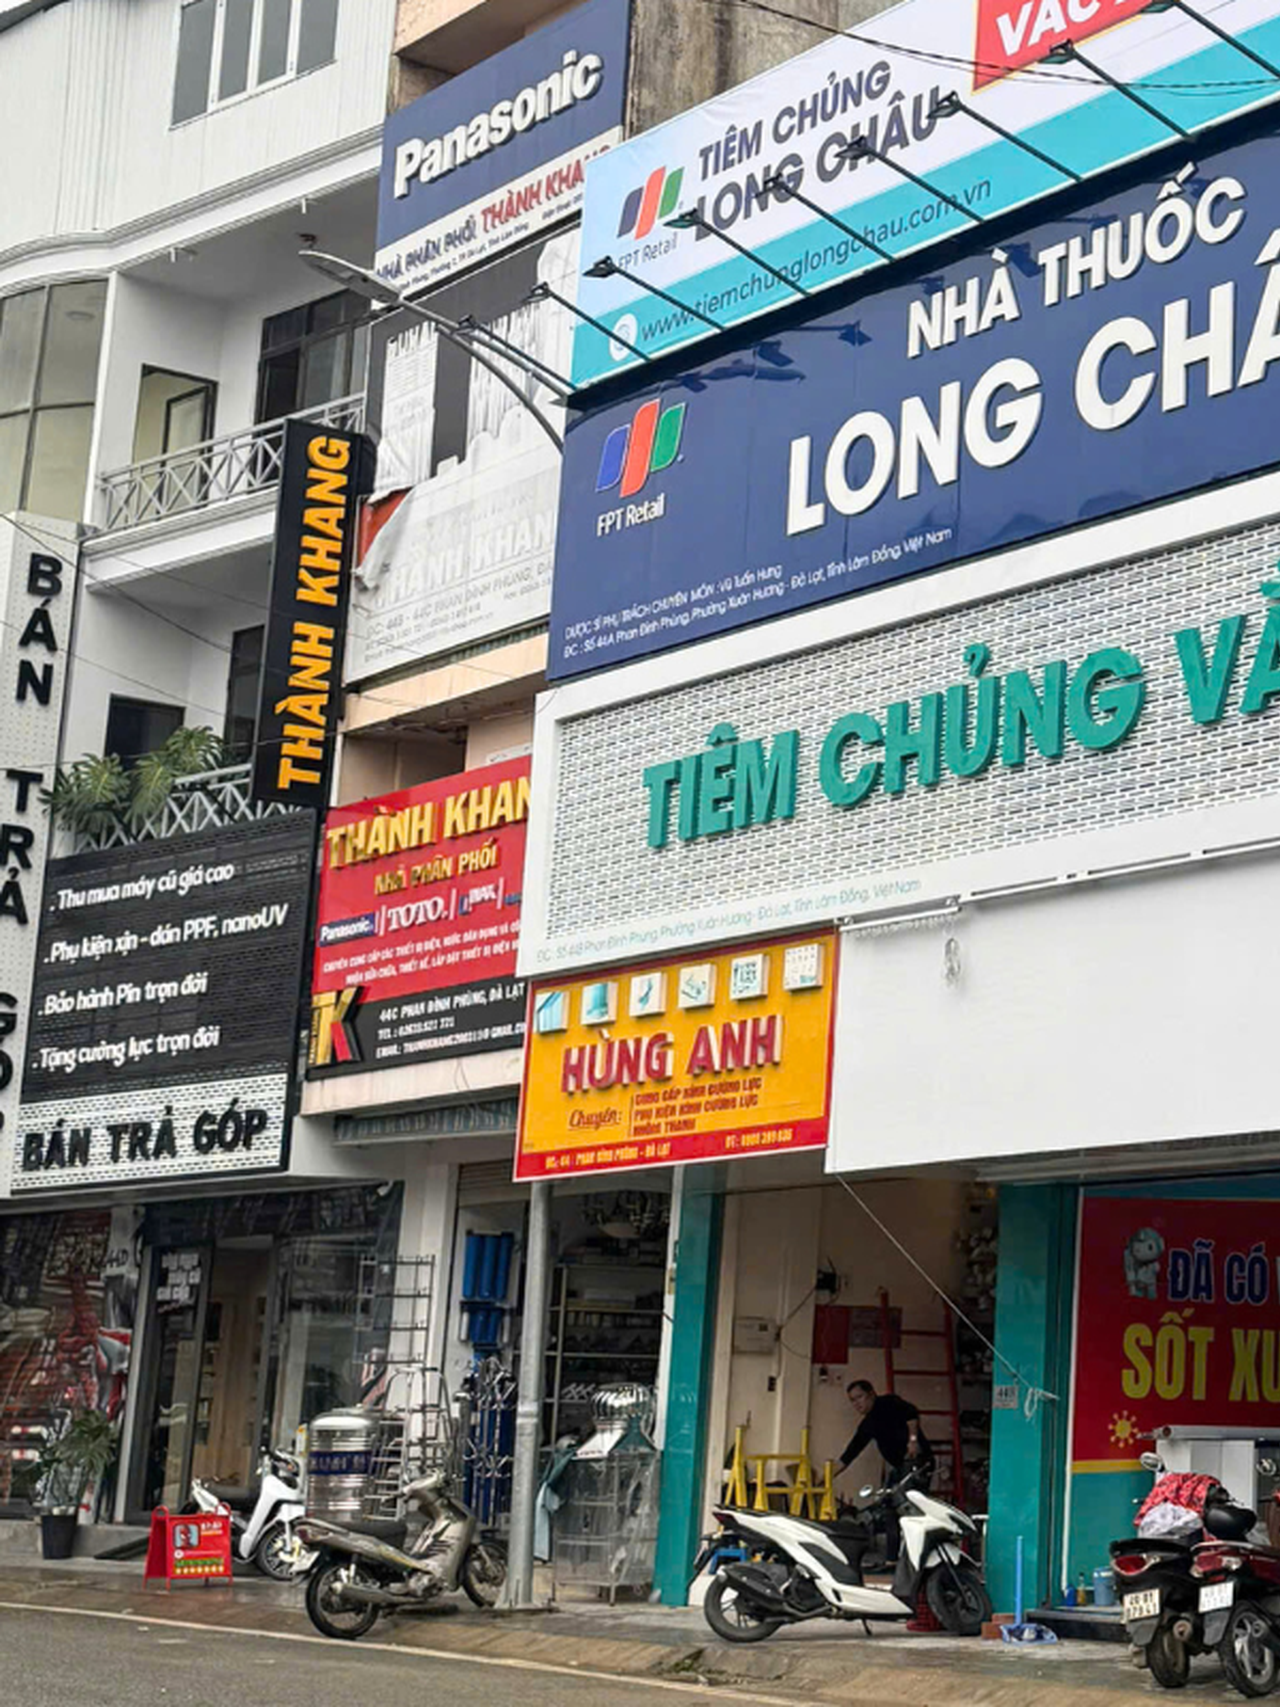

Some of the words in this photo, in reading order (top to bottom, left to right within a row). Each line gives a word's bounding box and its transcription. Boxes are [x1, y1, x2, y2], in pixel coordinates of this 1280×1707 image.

[393, 50, 603, 198] Panasonic
[700, 126, 762, 182] TIÊM
[772, 60, 892, 145] CHỦNG
[695, 153, 805, 242] LONG
[815, 86, 942, 185] CHÂU
[481, 183, 543, 234] THÀNH
[641, 232, 679, 264] Retail
[641, 179, 992, 342] www.tiemchunglongchau.com.vn
[907, 247, 1021, 360] NHÀ
[1038, 162, 1247, 307] THUỐC
[785, 357, 1044, 537] LONG
[296, 435, 352, 607] KHANG
[597, 507, 625, 537] FPT
[626, 492, 666, 523] Retail
[615, 626, 639, 644] Phan
[924, 528, 953, 548] Nam
[15, 552, 63, 707] BÁN
[275, 620, 335, 790] THÀNH
[642, 721, 800, 850] TIÊM
[820, 643, 1147, 808] CHỦNG
[326, 803, 436, 871] THÀNH
[374, 863, 408, 896] NHÀ
[410, 856, 453, 888] PHÂN
[458, 837, 501, 876] PHỐI
[58, 888, 89, 910] Thu
[88, 884, 120, 905] mua
[121, 876, 156, 904] máy
[157, 872, 179, 890] cũ
[180, 864, 205, 896] giá
[205, 863, 235, 881] cao
[50, 941, 81, 964] Phụ
[81, 931, 114, 960] kiện
[115, 930, 139, 953] xịn
[149, 923, 181, 947] dán
[221, 903, 289, 937] nanoUV
[319, 918, 374, 943] Panasonic
[44, 990, 75, 1015] Bảo
[75, 985, 115, 1011] hành
[144, 979, 179, 1003] trọn
[180, 972, 209, 996] đời
[378, 1008, 400, 1023] 44C
[400, 1004, 426, 1019] PHAN
[427, 996, 452, 1015] ĐÌNH
[489, 986, 504, 1003] ĐÀ
[505, 982, 525, 1002] LẠT
[39, 1046, 78, 1073] Tặng
[78, 1038, 127, 1067] cường
[127, 1035, 154, 1060] lực
[156, 1031, 191, 1055] trọn
[192, 1025, 221, 1049] đời
[561, 1027, 675, 1095] HÙNG
[686, 1015, 784, 1077] ANH
[635, 1091, 660, 1106] CUNG
[661, 1087, 682, 1102] CẤP
[741, 1077, 762, 1094] LỰC
[738, 1094, 759, 1109] LỰC
[22, 1117, 92, 1173] BÁN
[106, 1105, 179, 1163] TRẢ
[192, 1097, 270, 1155] GÓP
[1167, 1237, 1216, 1302] ĐÃ
[1224, 1243, 1270, 1306] CÓ
[1121, 1308, 1215, 1401] SỐT
